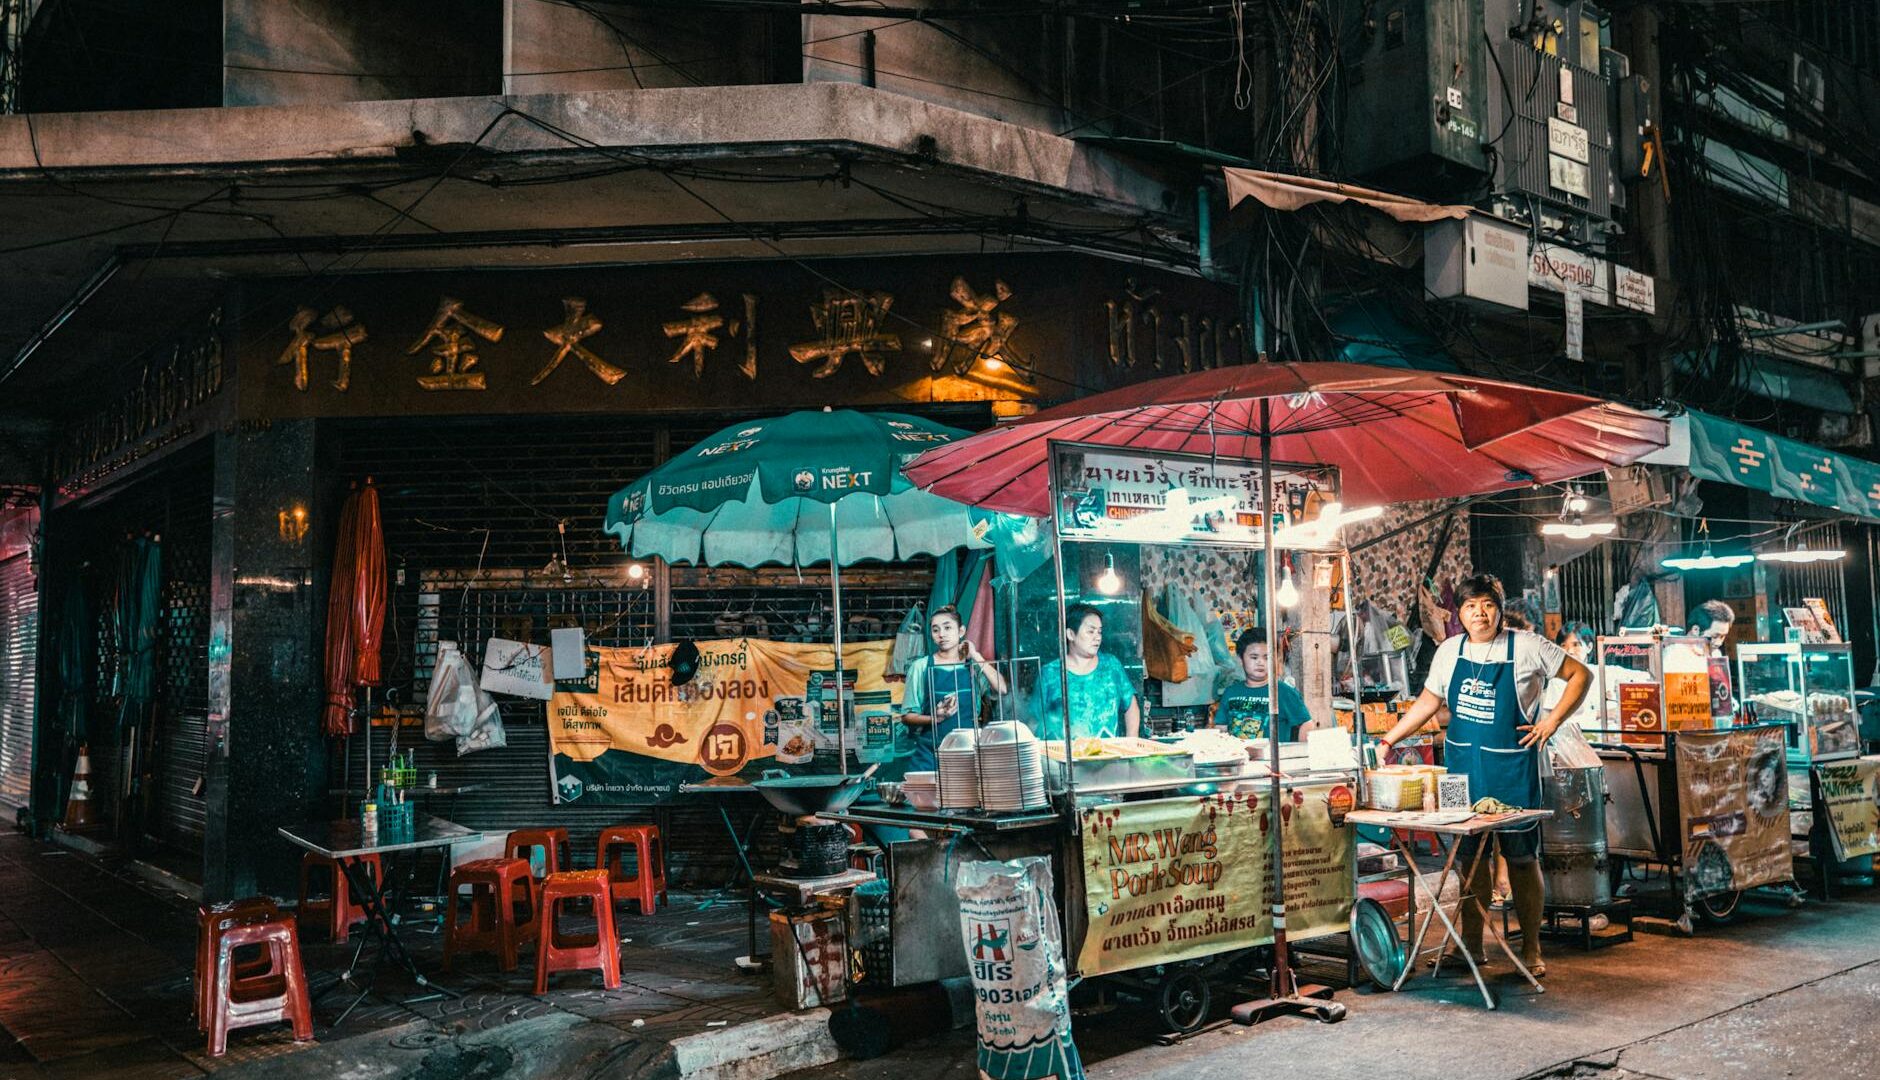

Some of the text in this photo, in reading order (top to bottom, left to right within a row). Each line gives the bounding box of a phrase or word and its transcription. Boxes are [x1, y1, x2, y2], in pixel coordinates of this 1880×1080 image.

[1550, 127, 1587, 160] เอกรัฐ
[1552, 261, 1594, 286] 22506
[891, 433, 950, 442] NEXT
[698, 440, 760, 457] NEXT
[659, 482, 699, 496] ชีวิตครบ
[822, 472, 872, 490] NEXT
[1110, 863, 1167, 900] Pork
[1165, 858, 1223, 891] Soup
[1110, 895, 1226, 928] เกาเหลาเลือดหมู
